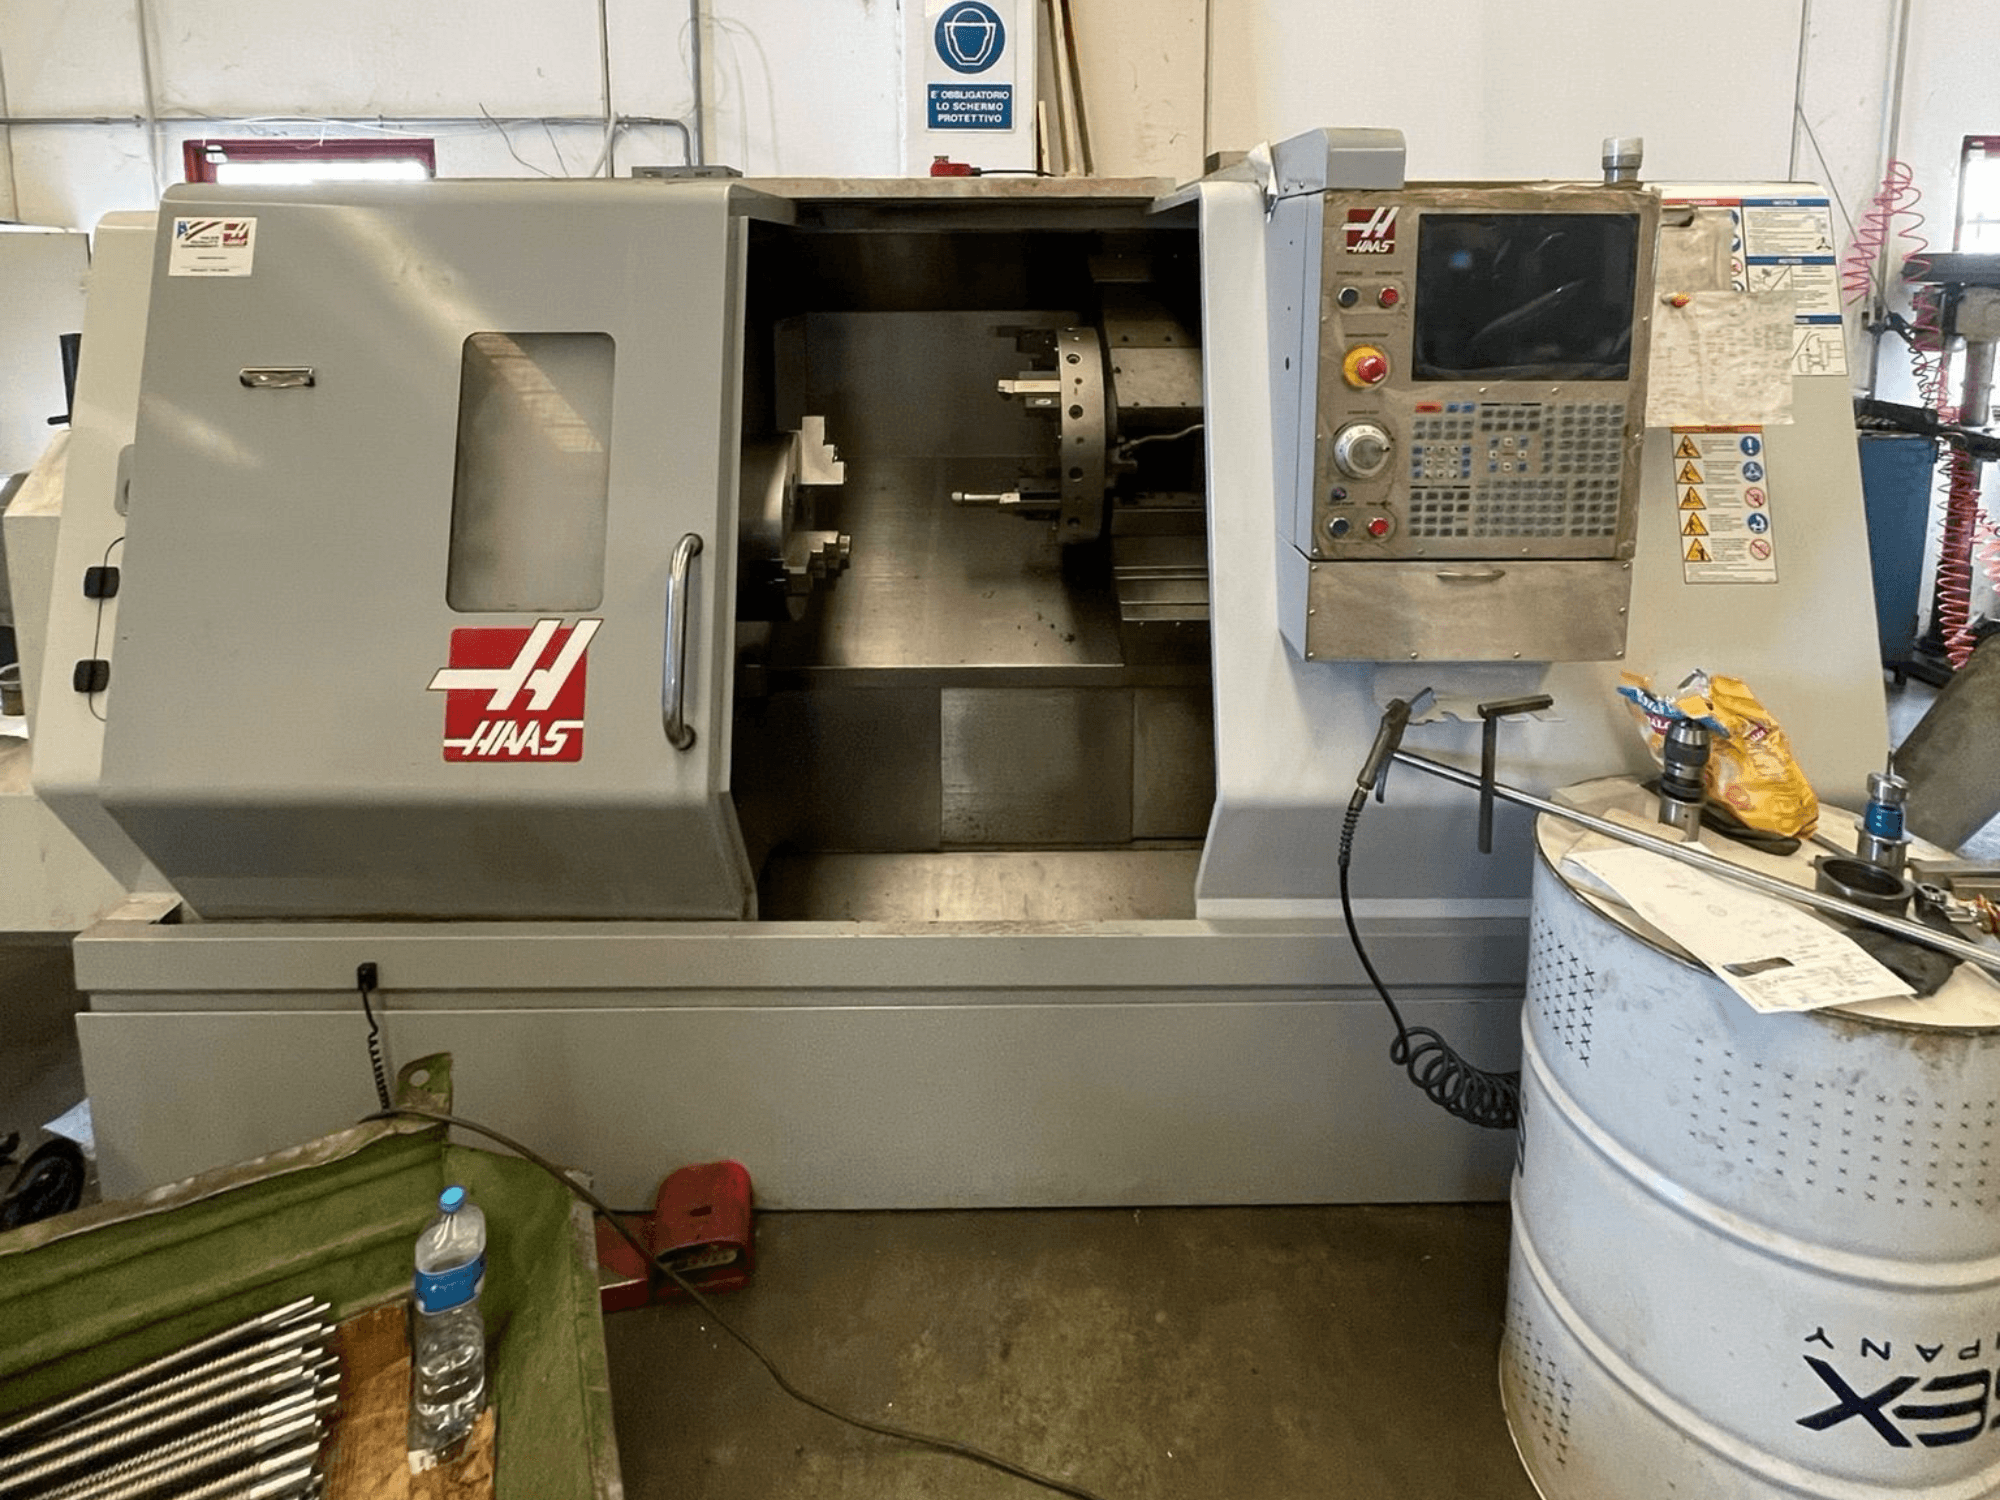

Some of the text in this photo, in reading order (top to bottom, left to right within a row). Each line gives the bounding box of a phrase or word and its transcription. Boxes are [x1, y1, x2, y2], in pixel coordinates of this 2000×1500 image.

[941, 91, 1009, 100] OBBLIGATORIO
[936, 102, 1004, 111] LO SCHERMO
[937, 113, 1002, 123] PROTETTIVO
[1346, 240, 1396, 253] HAAS
[443, 719, 585, 756] HAAS
